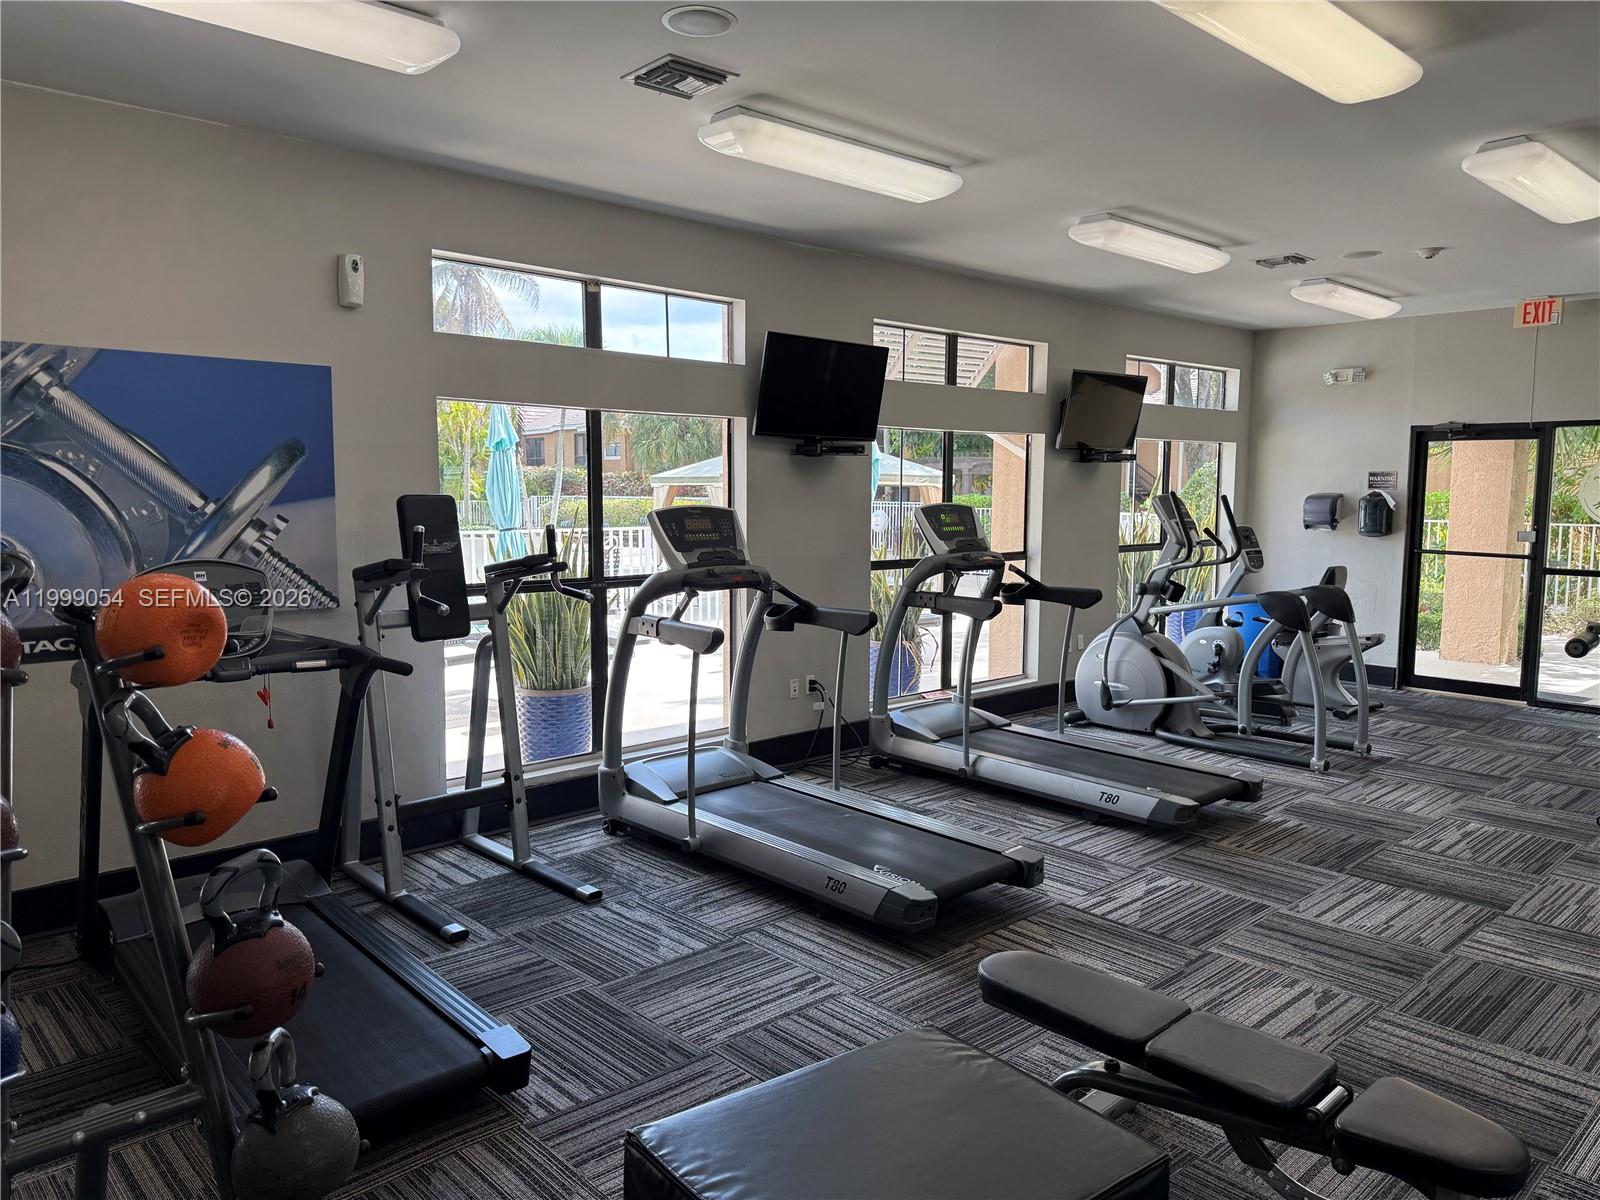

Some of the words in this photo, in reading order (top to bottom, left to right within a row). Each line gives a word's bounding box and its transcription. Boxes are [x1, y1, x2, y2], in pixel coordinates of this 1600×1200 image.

[1522, 299, 1556, 325] EXIT
[21, 637, 77, 654] TAG
[1099, 791, 1120, 805] T80
[825, 875, 847, 895] T80
